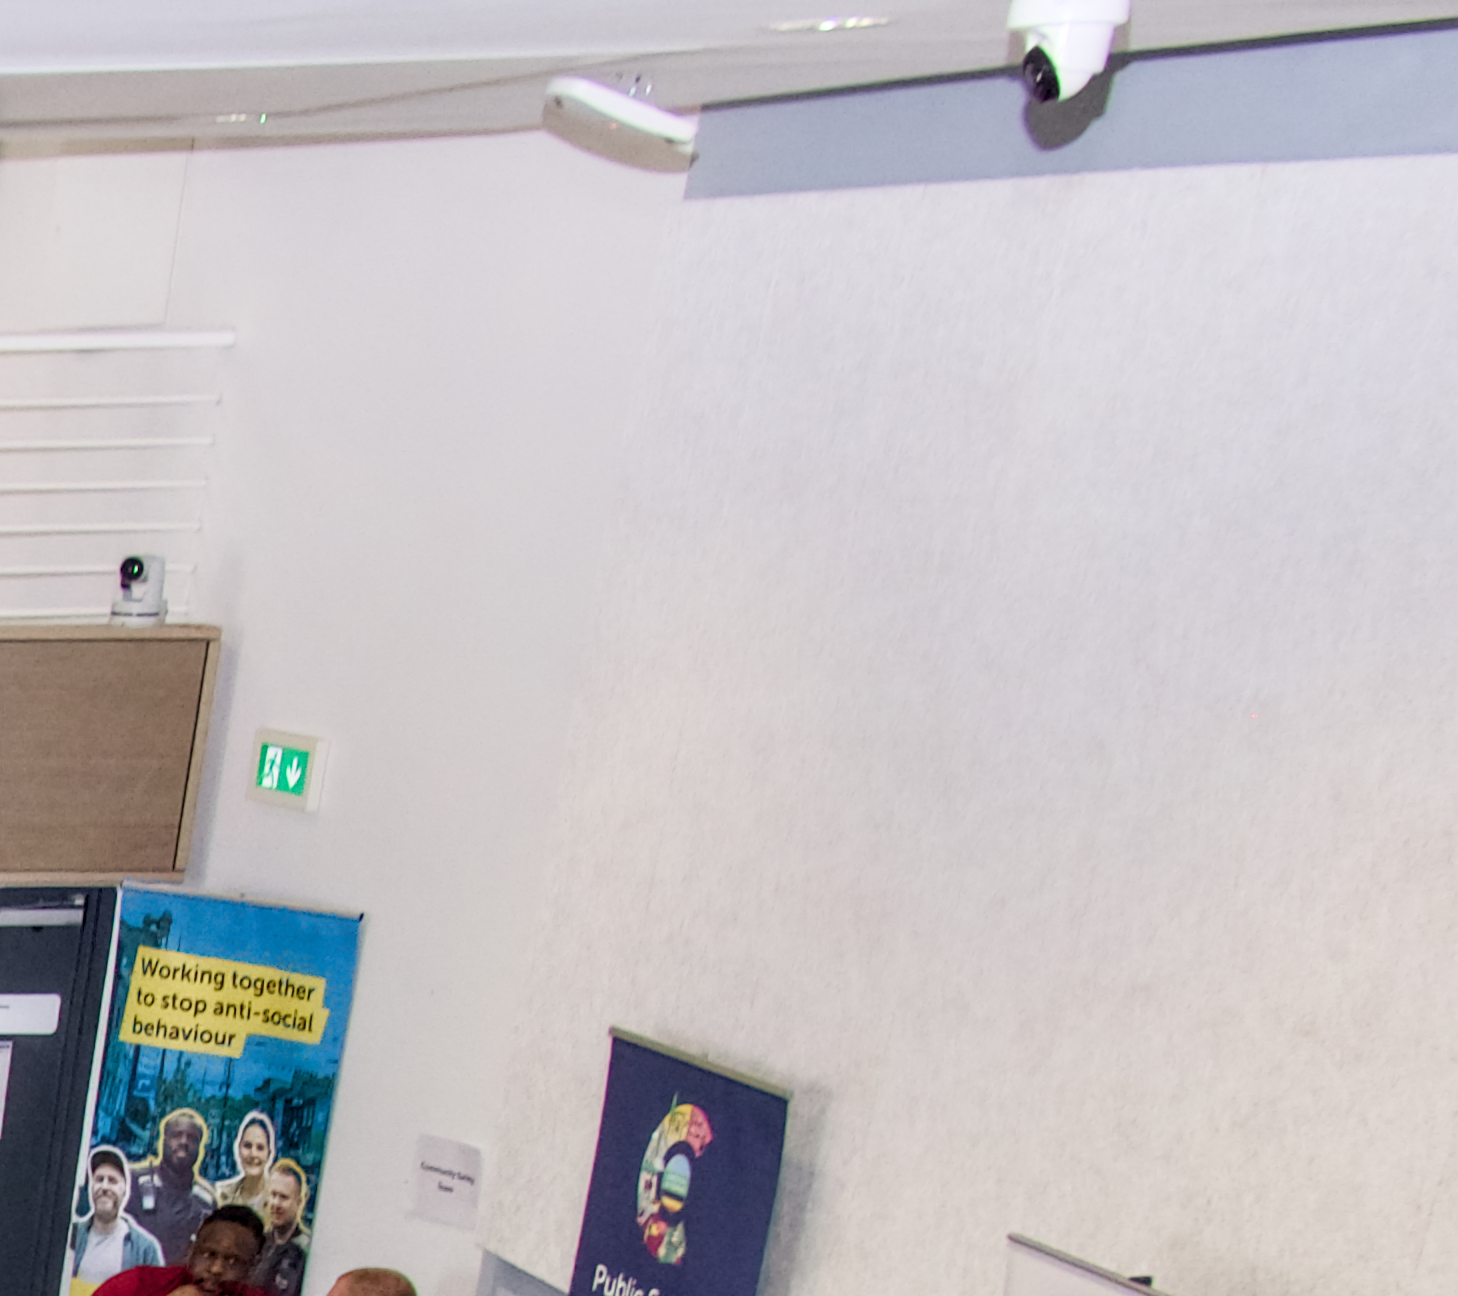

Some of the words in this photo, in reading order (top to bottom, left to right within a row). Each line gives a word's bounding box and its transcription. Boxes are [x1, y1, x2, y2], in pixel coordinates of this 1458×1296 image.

[141, 957, 225, 991] Working
[232, 971, 316, 1002] together
[132, 1014, 236, 1047] behaviour
[137, 987, 155, 1007] to
[161, 992, 207, 1017] stop
[213, 1001, 313, 1033] anti-social
